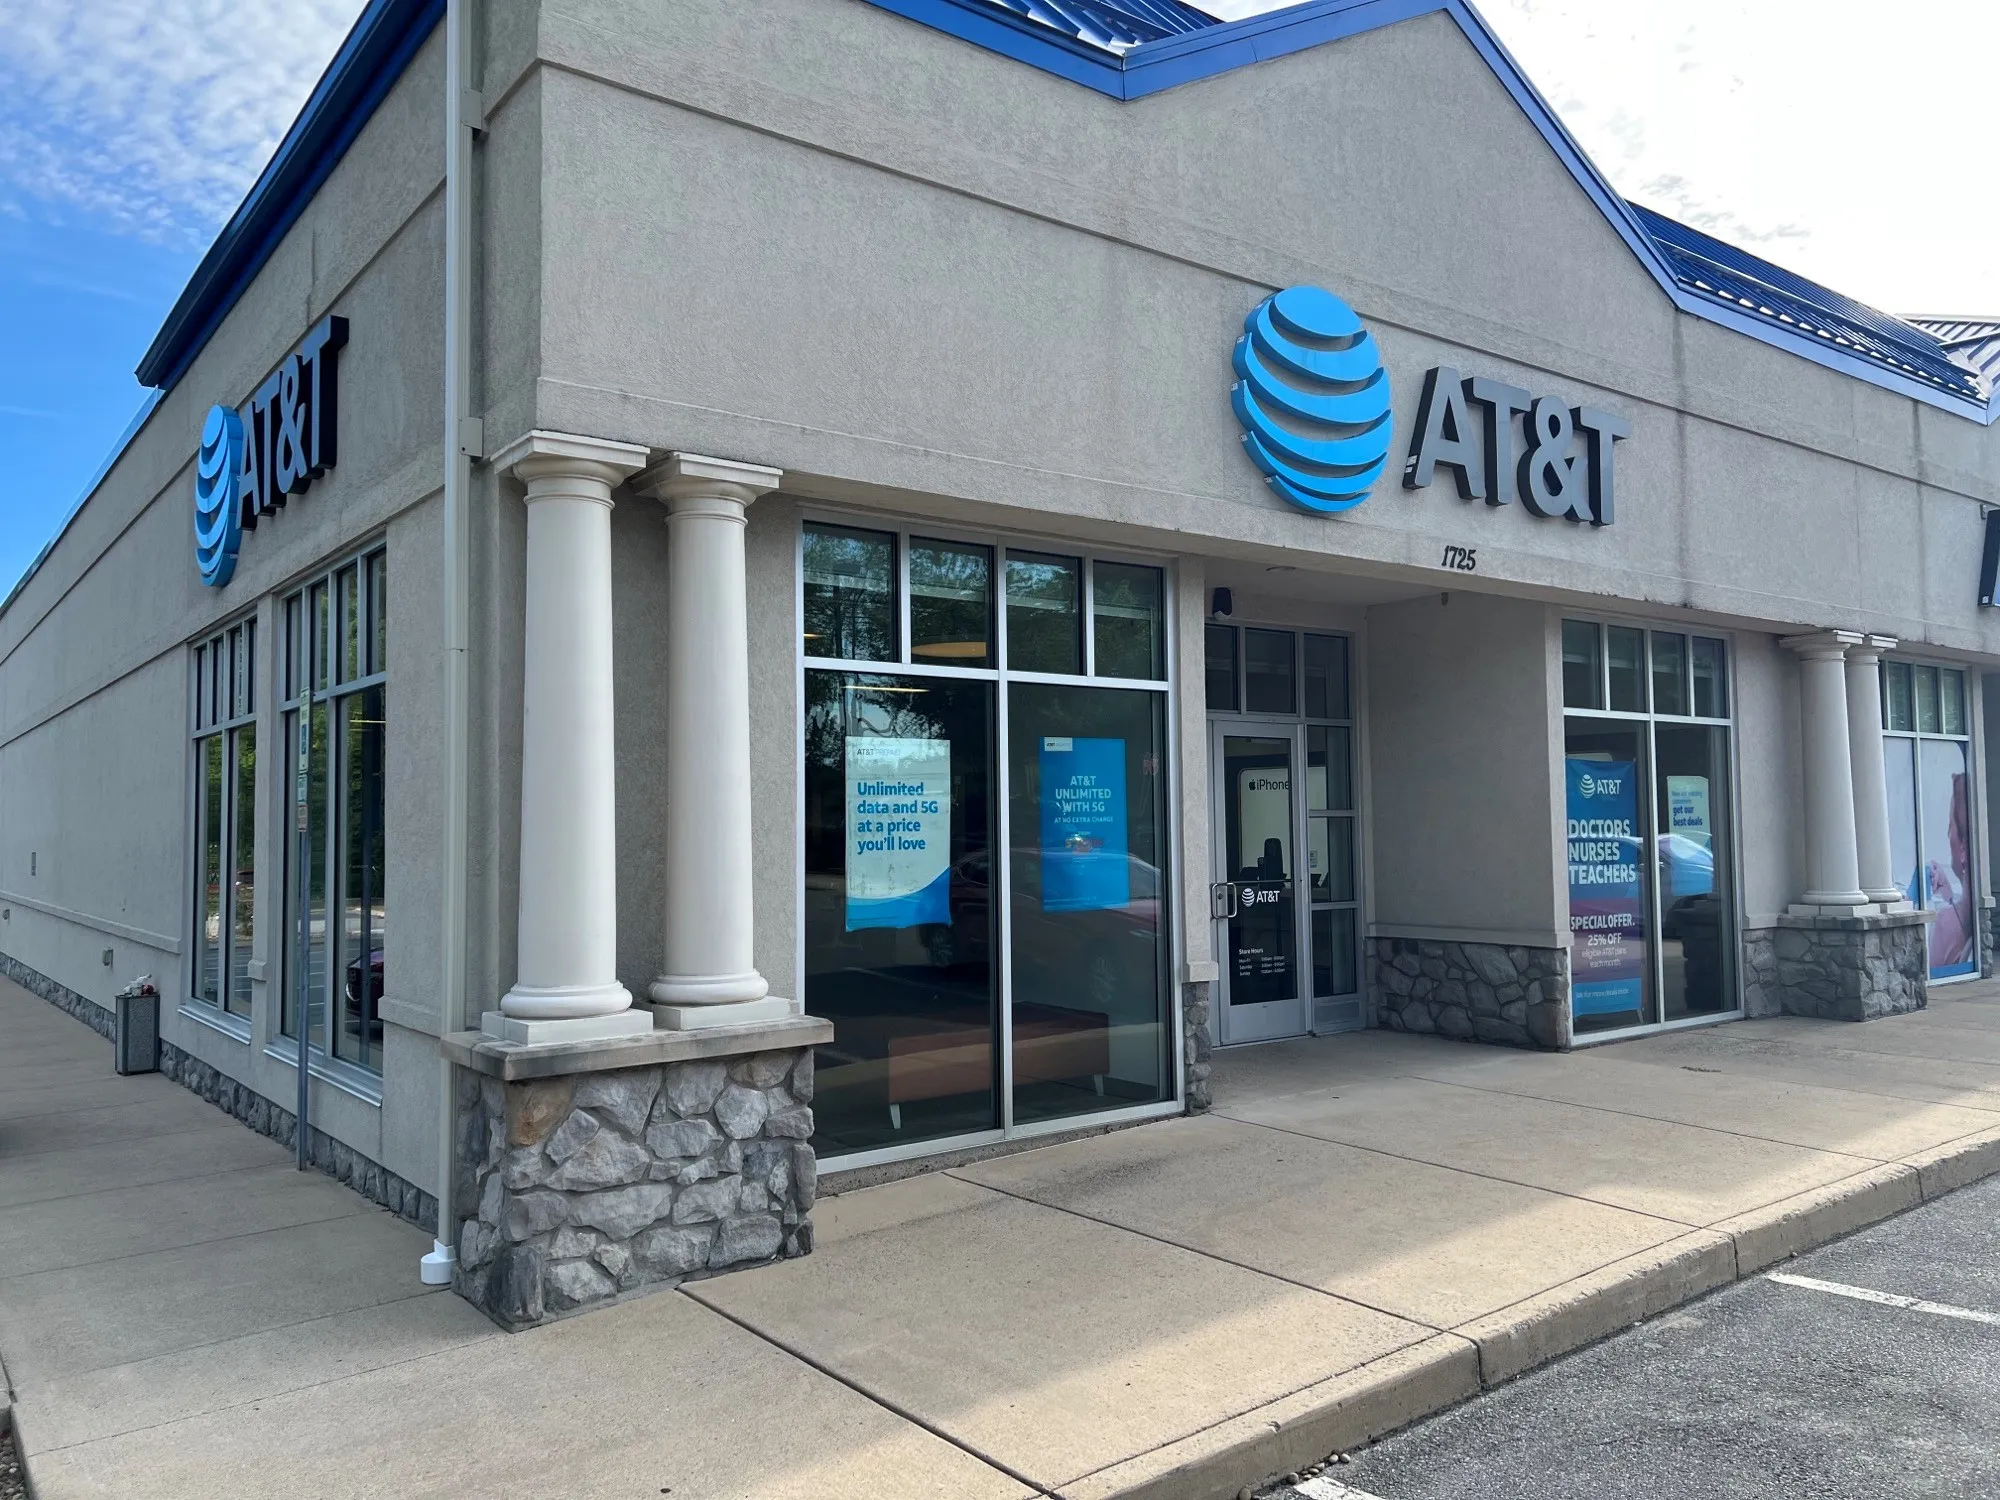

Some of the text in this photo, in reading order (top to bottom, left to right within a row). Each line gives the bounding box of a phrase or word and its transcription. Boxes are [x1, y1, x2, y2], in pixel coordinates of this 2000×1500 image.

[236, 315, 345, 530] AT&T
[1404, 366, 1631, 526] AT&T
[1441, 545, 1477, 571] 1725
[857, 748, 874, 756] AT&T
[1070, 775, 1097, 786] AT&T
[1256, 779, 1289, 791] iPhone
[1597, 779, 1622, 795] AT&T
[857, 781, 924, 796] Unlimited
[1055, 788, 1112, 799] UNLIMITED
[857, 800, 938, 814] data and 5G
[1062, 801, 1105, 813] WITH 5G
[1673, 806, 1694, 816] get our
[1054, 815, 1114, 824] AT NO EXTRA CHARGE
[1673, 816, 1703, 826] best deals
[857, 818, 921, 836] at a price
[1568, 819, 1631, 839] DOCTORS
[898, 836, 926, 850] love
[1569, 841, 1620, 862] NURSES
[1569, 864, 1637, 885] TEACHERS
[1256, 890, 1280, 903] AT&T
[1570, 913, 1635, 930] SPECIAL OFFER.
[1588, 932, 1621, 946] 25% OFF
[1589, 960, 1603, 968] each
